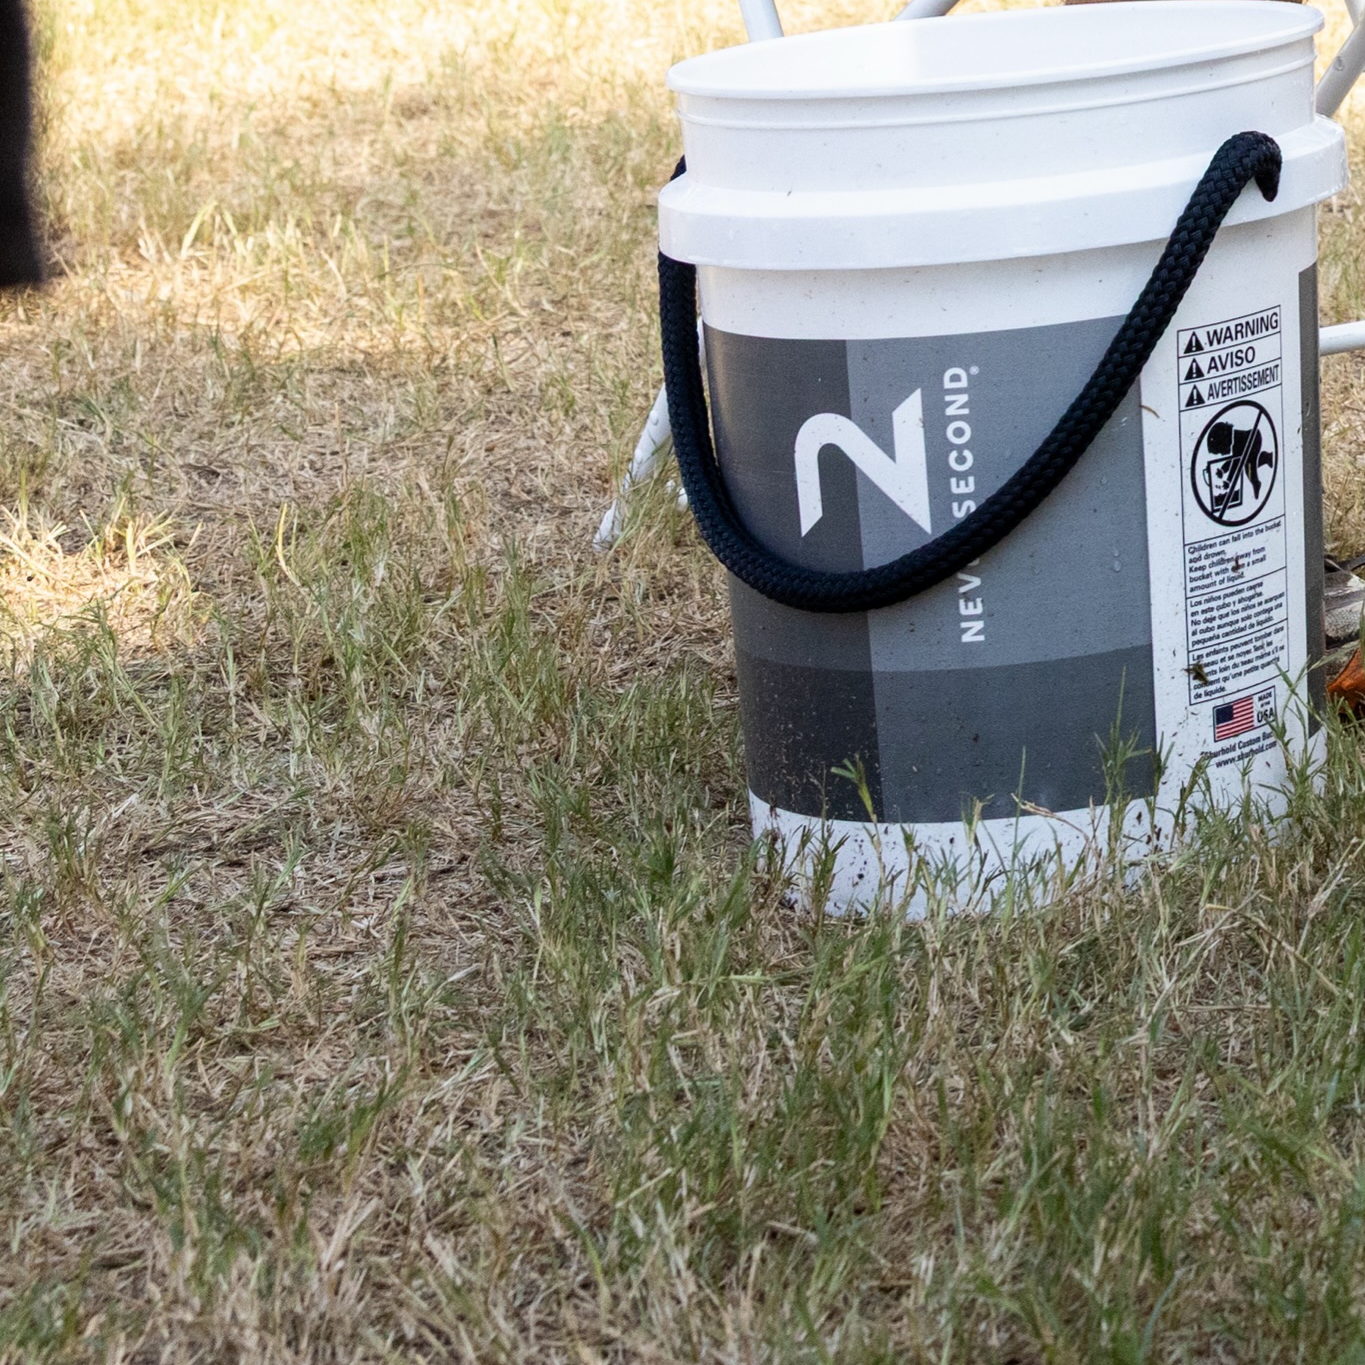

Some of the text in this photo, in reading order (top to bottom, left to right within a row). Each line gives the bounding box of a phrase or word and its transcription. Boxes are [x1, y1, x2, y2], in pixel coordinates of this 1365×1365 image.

[1206, 312, 1279, 347] WARNING
[1207, 346, 1256, 375] AVISO
[1207, 364, 1280, 401] AVERTISSEMENT
[944, 367, 986, 643] NEVSECOND
[1188, 520, 1281, 555] Children can fall into the bucket
[1188, 554, 1202, 564] and
[1188, 563, 1207, 574] Keep
[1208, 556, 1234, 569] children
[1252, 546, 1265, 555] from
[1188, 572, 1212, 583] bucket
[1214, 567, 1230, 577] with
[1251, 554, 1267, 566] small
[1189, 580, 1217, 593] amount
[1218, 577, 1225, 586] of
[1190, 600, 1203, 608] Los
[1204, 594, 1222, 604] niños
[1222, 587, 1246, 600] pueden
[1190, 610, 1199, 618] en
[1200, 606, 1215, 615] este
[1215, 601, 1232, 612] cubo
[1190, 619, 1202, 627] No
[1202, 615, 1217, 625] deje
[1217, 612, 1230, 621] que
[1230, 608, 1240, 616] los
[1191, 628, 1198, 637] al
[1198, 625, 1215, 635] cubo
[1216, 619, 1240, 631] aunque
[1274, 602, 1283, 611] una
[1221, 624, 1248, 639] cantidad
[1248, 622, 1256, 630] de
[1192, 625, 1285, 662] Les enfants peuvent tomber dans
[1219, 655, 1227, 664] et
[1227, 654, 1235, 662] se
[1265, 639, 1274, 648] les
[1218, 664, 1231, 674] loin
[1231, 662, 1240, 670] du
[1240, 657, 1254, 667] seau
[1243, 664, 1260, 677] petite
[1193, 691, 1203, 700] de
[1258, 690, 1272, 702] MADE
[1257, 707, 1274, 723] USA
[1237, 735, 1262, 750] Custom
